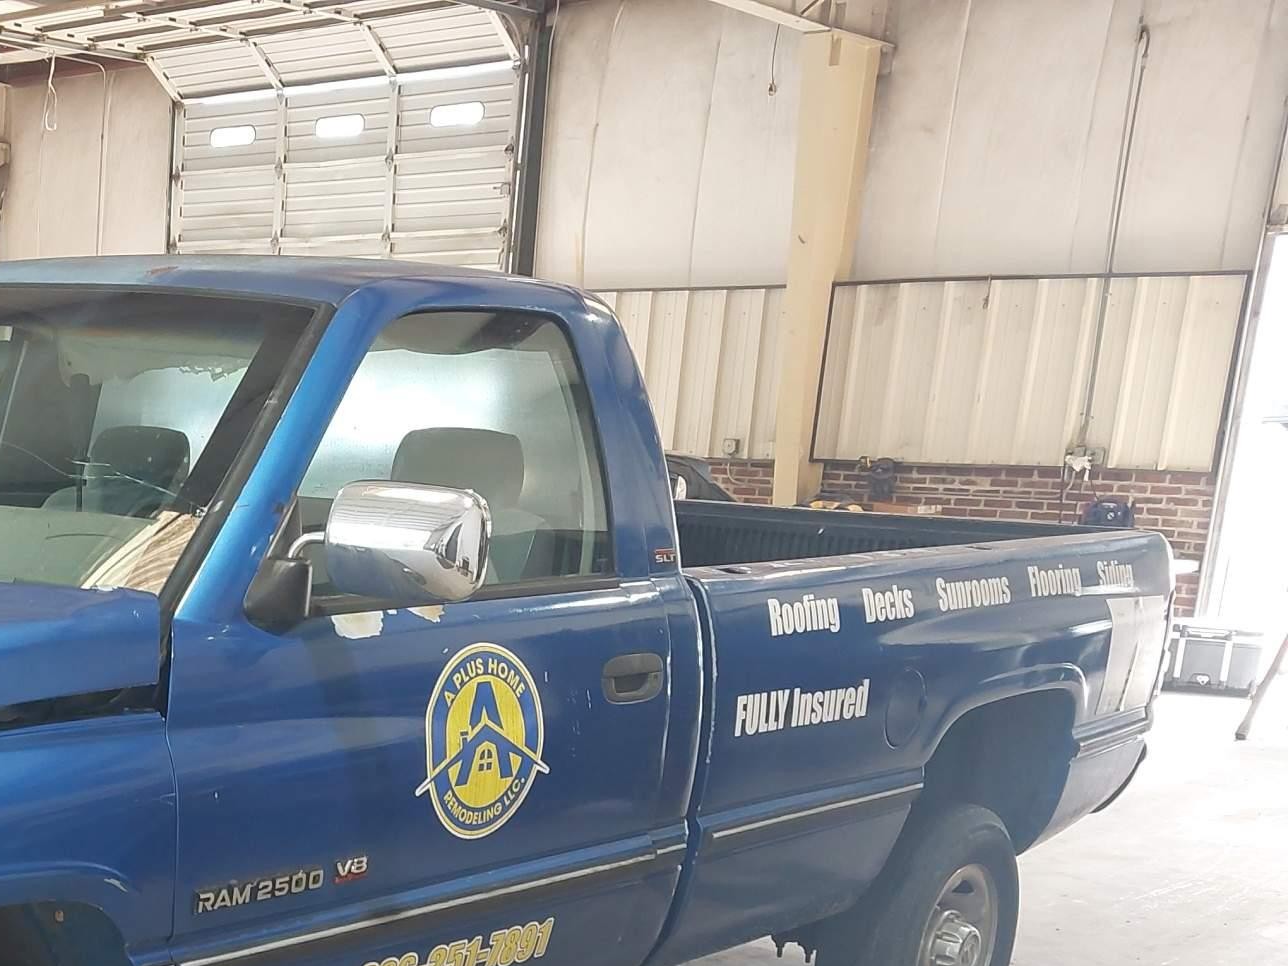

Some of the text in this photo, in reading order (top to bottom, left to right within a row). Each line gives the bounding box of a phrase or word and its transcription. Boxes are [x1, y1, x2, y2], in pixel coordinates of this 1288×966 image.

[655, 553, 676, 563] SLT
[767, 560, 1135, 637] Roofing Decks Sunrooms Flooring Siding
[443, 657, 526, 708] A PLUS HOME
[734, 678, 871, 737] FULLY Insured
[443, 776, 526, 826] REMODELING LLC.
[198, 856, 368, 914] RAM 2500 V8
